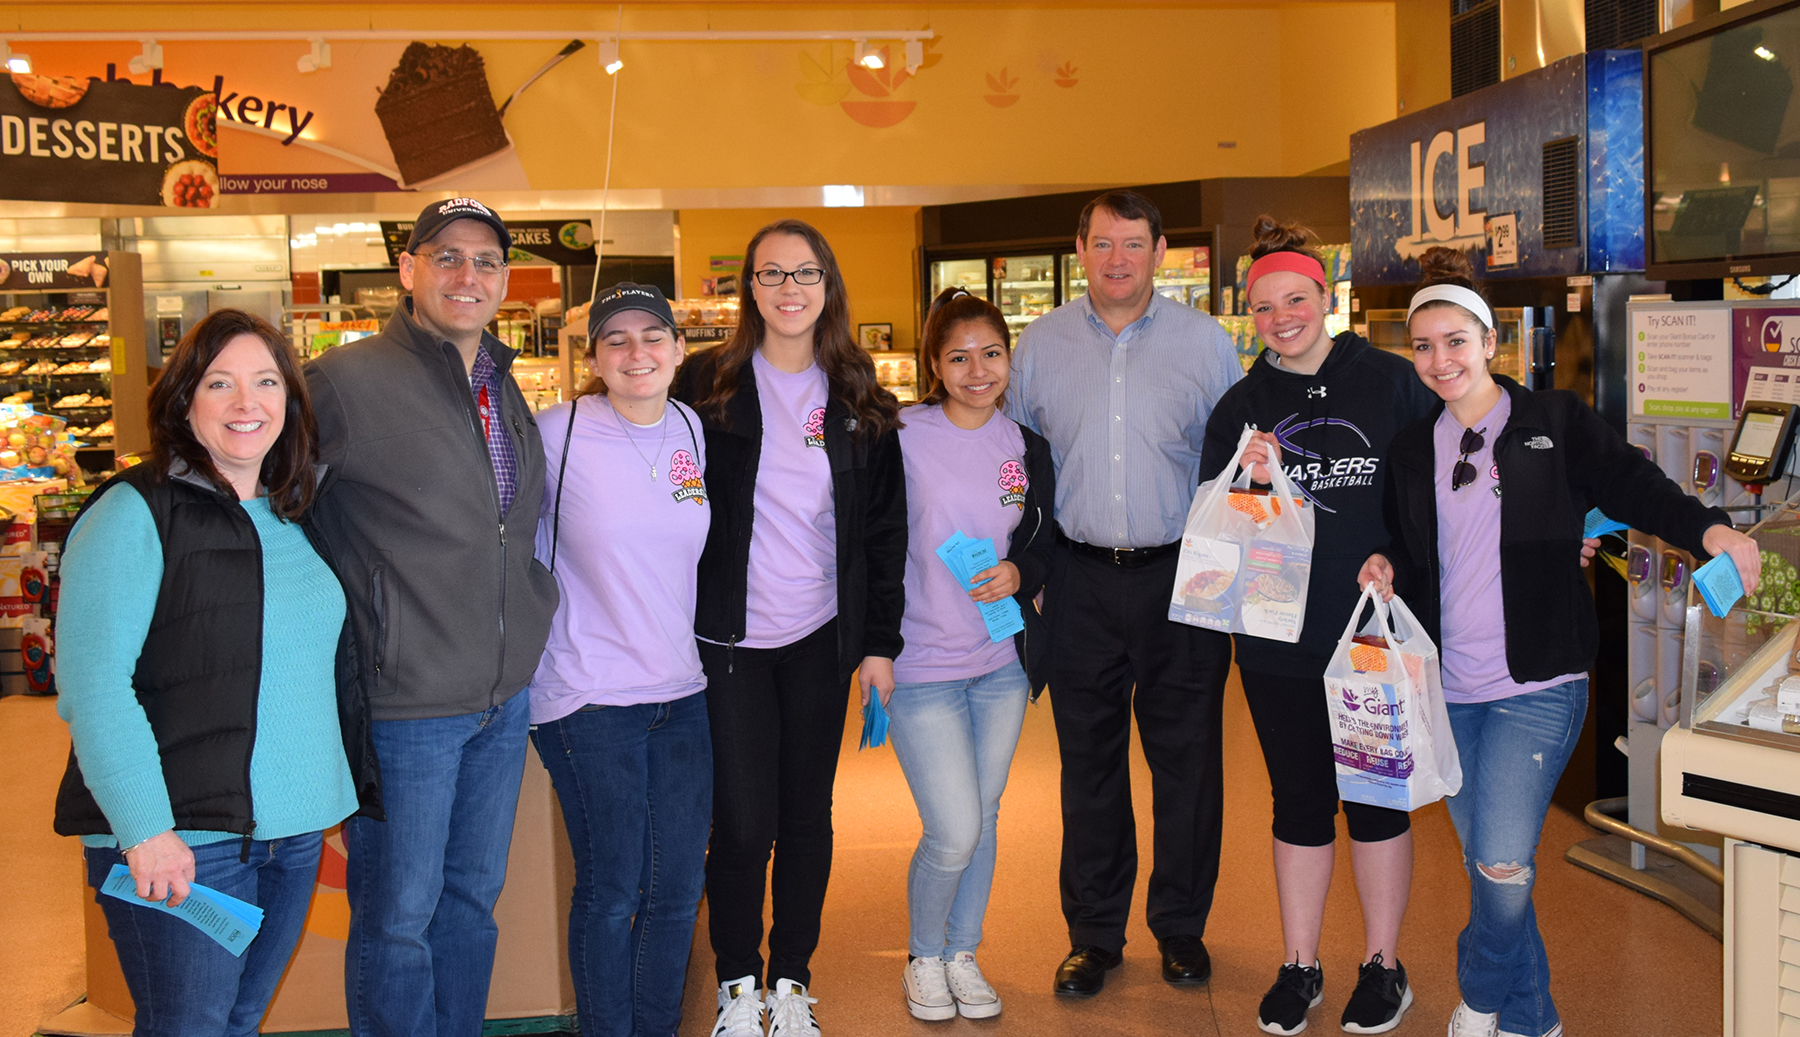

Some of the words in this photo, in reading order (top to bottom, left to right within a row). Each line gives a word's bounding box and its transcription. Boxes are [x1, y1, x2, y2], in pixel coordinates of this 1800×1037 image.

[0, 114, 185, 164] DESSERTS
[218, 176, 250, 190] llow
[253, 179, 288, 192] your
[291, 178, 328, 190] nose
[1411, 121, 1487, 242] ICE
[509, 232, 552, 245] CAKES
[11, 260, 37, 272] PICK
[39, 259, 69, 272] YOUR
[28, 271, 54, 284] OWN
[602, 294, 616, 304] THE
[1647, 316, 1660, 329] Try
[1661, 315, 1684, 327] SCAN
[1686, 315, 1697, 326] IT!
[685, 328, 716, 338] MUFFINS
[1310, 476, 1373, 491] BASKETBALL
[1363, 697, 1406, 716] Giant
[1339, 721, 1347, 729] BY
[1341, 738, 1360, 749] MAKE
[1333, 745, 1359, 760] REDUCE
[1366, 756, 1389, 768] REUSE
